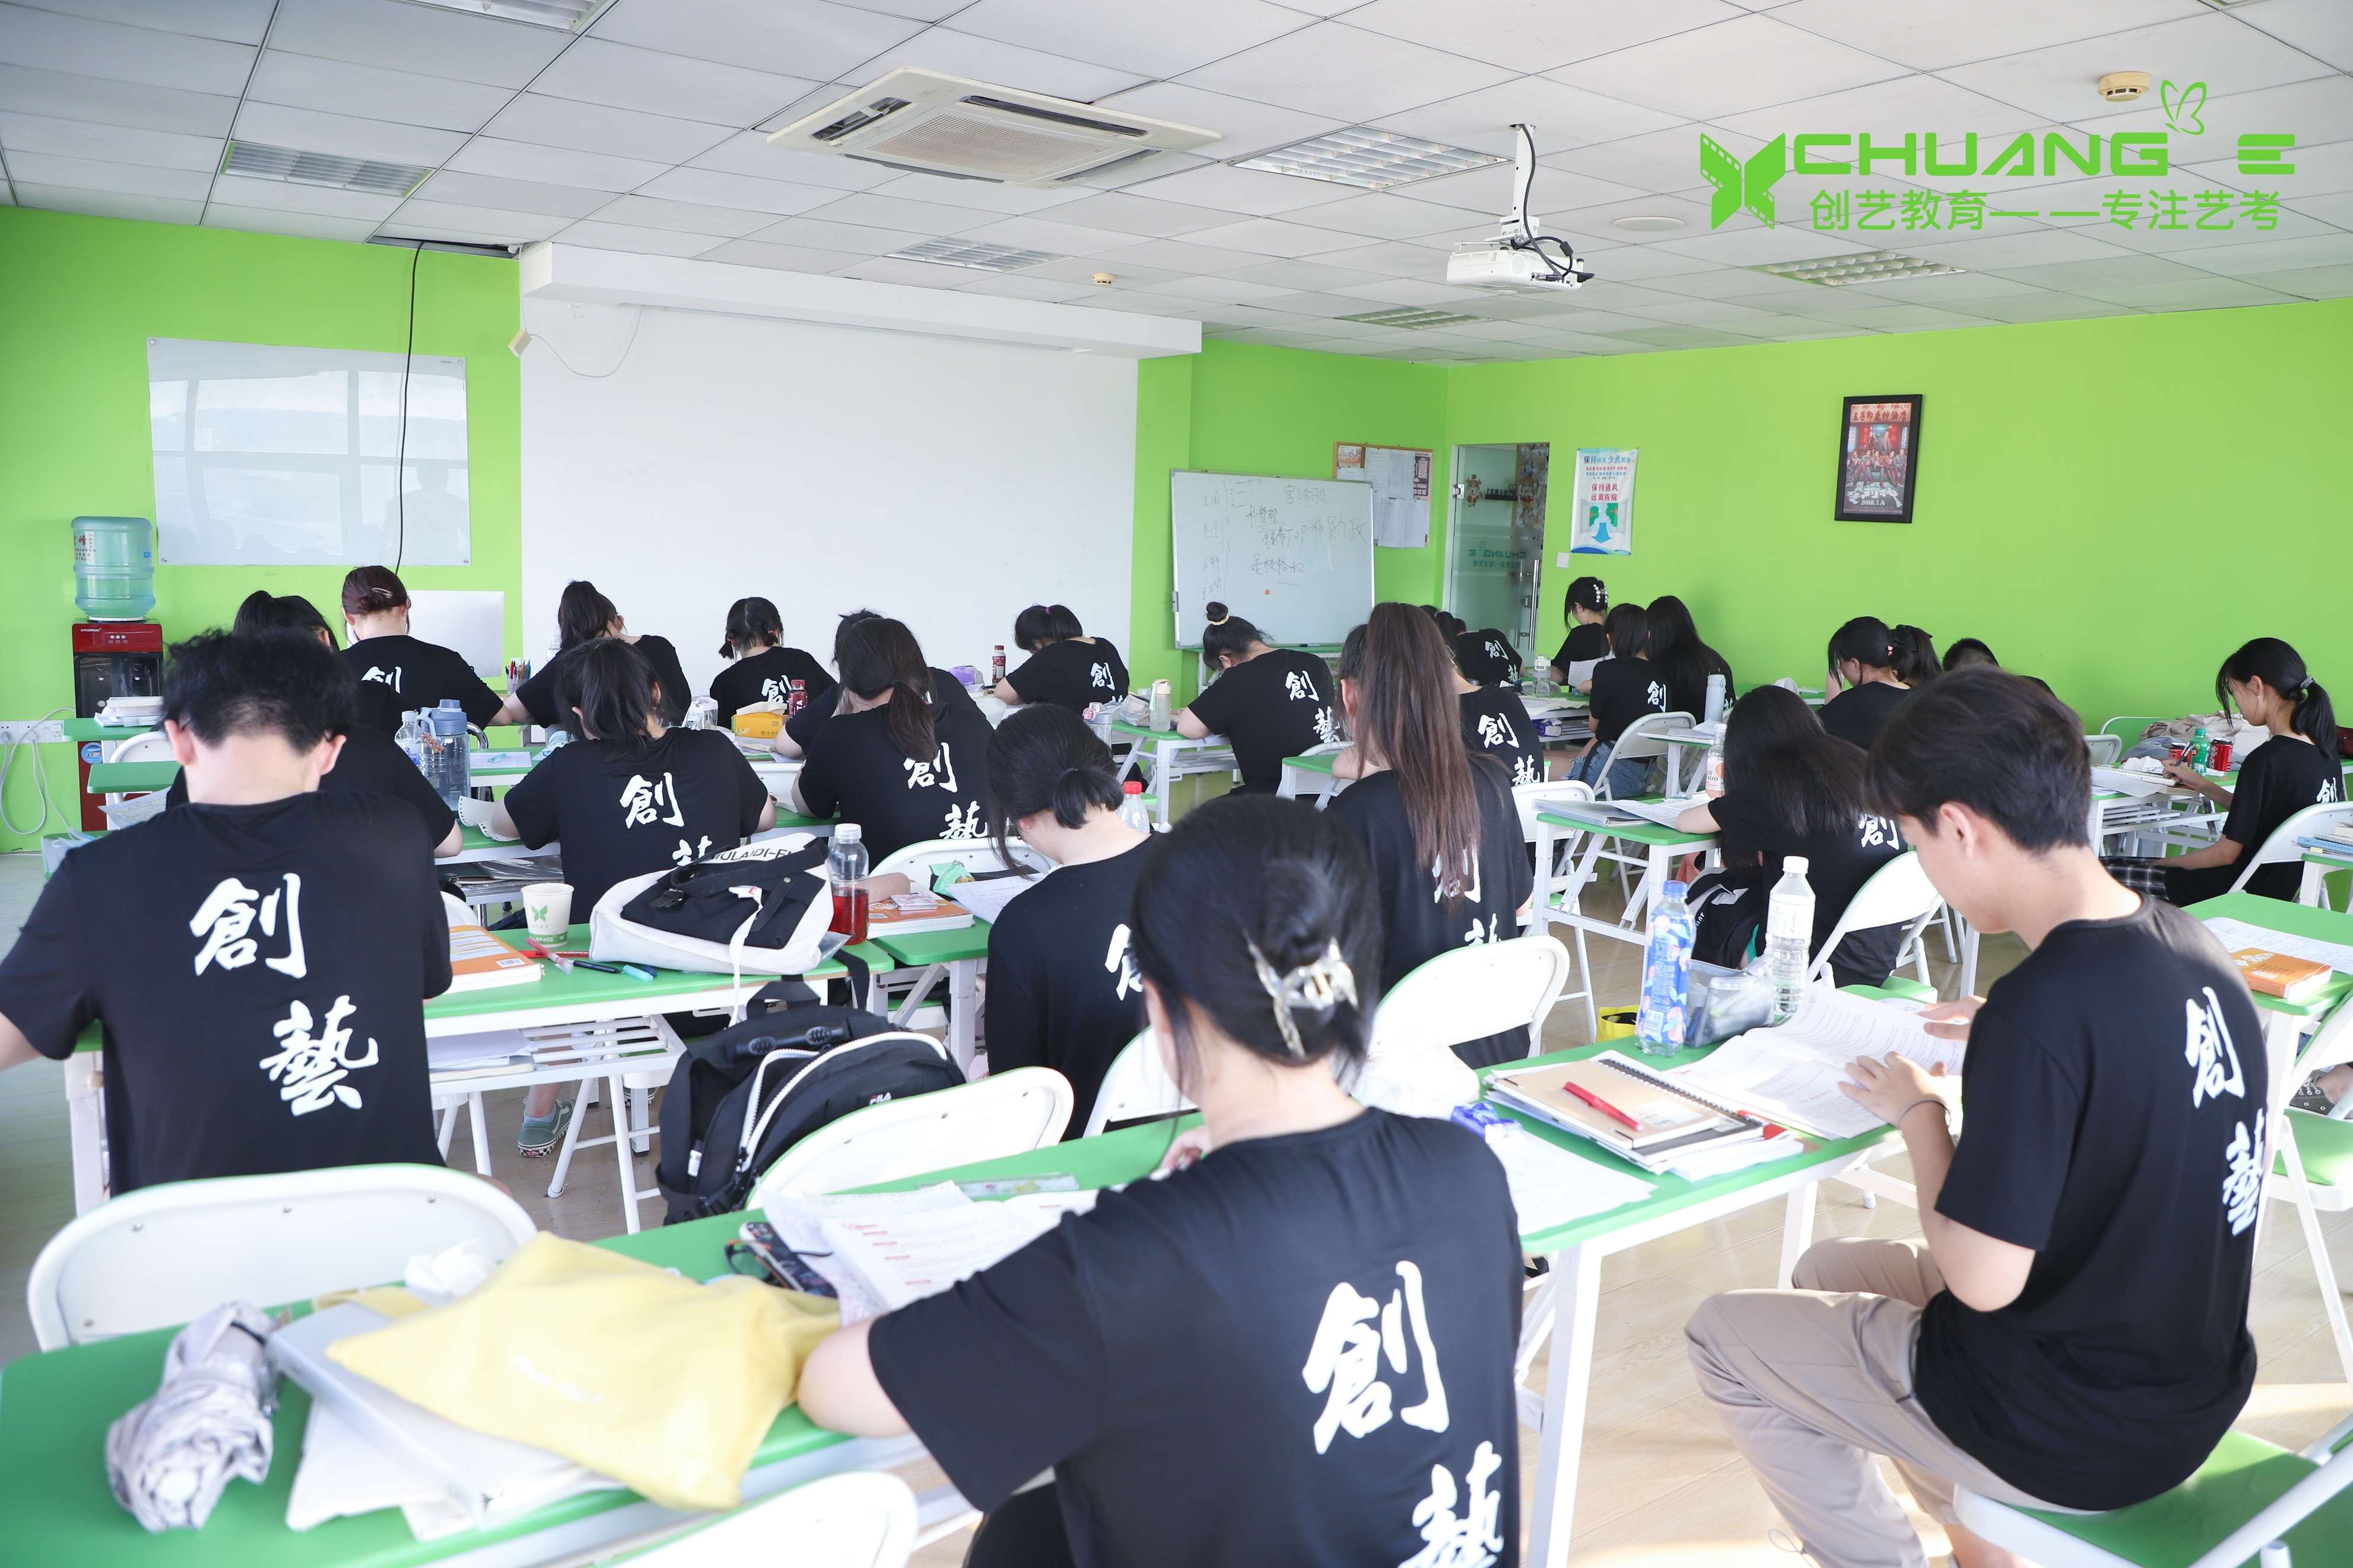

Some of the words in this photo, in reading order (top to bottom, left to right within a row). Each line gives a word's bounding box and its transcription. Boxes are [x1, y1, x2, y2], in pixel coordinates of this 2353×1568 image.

[1284, 484, 1329, 505] 宫崎骏
[869, 1092, 892, 1105] FILA
